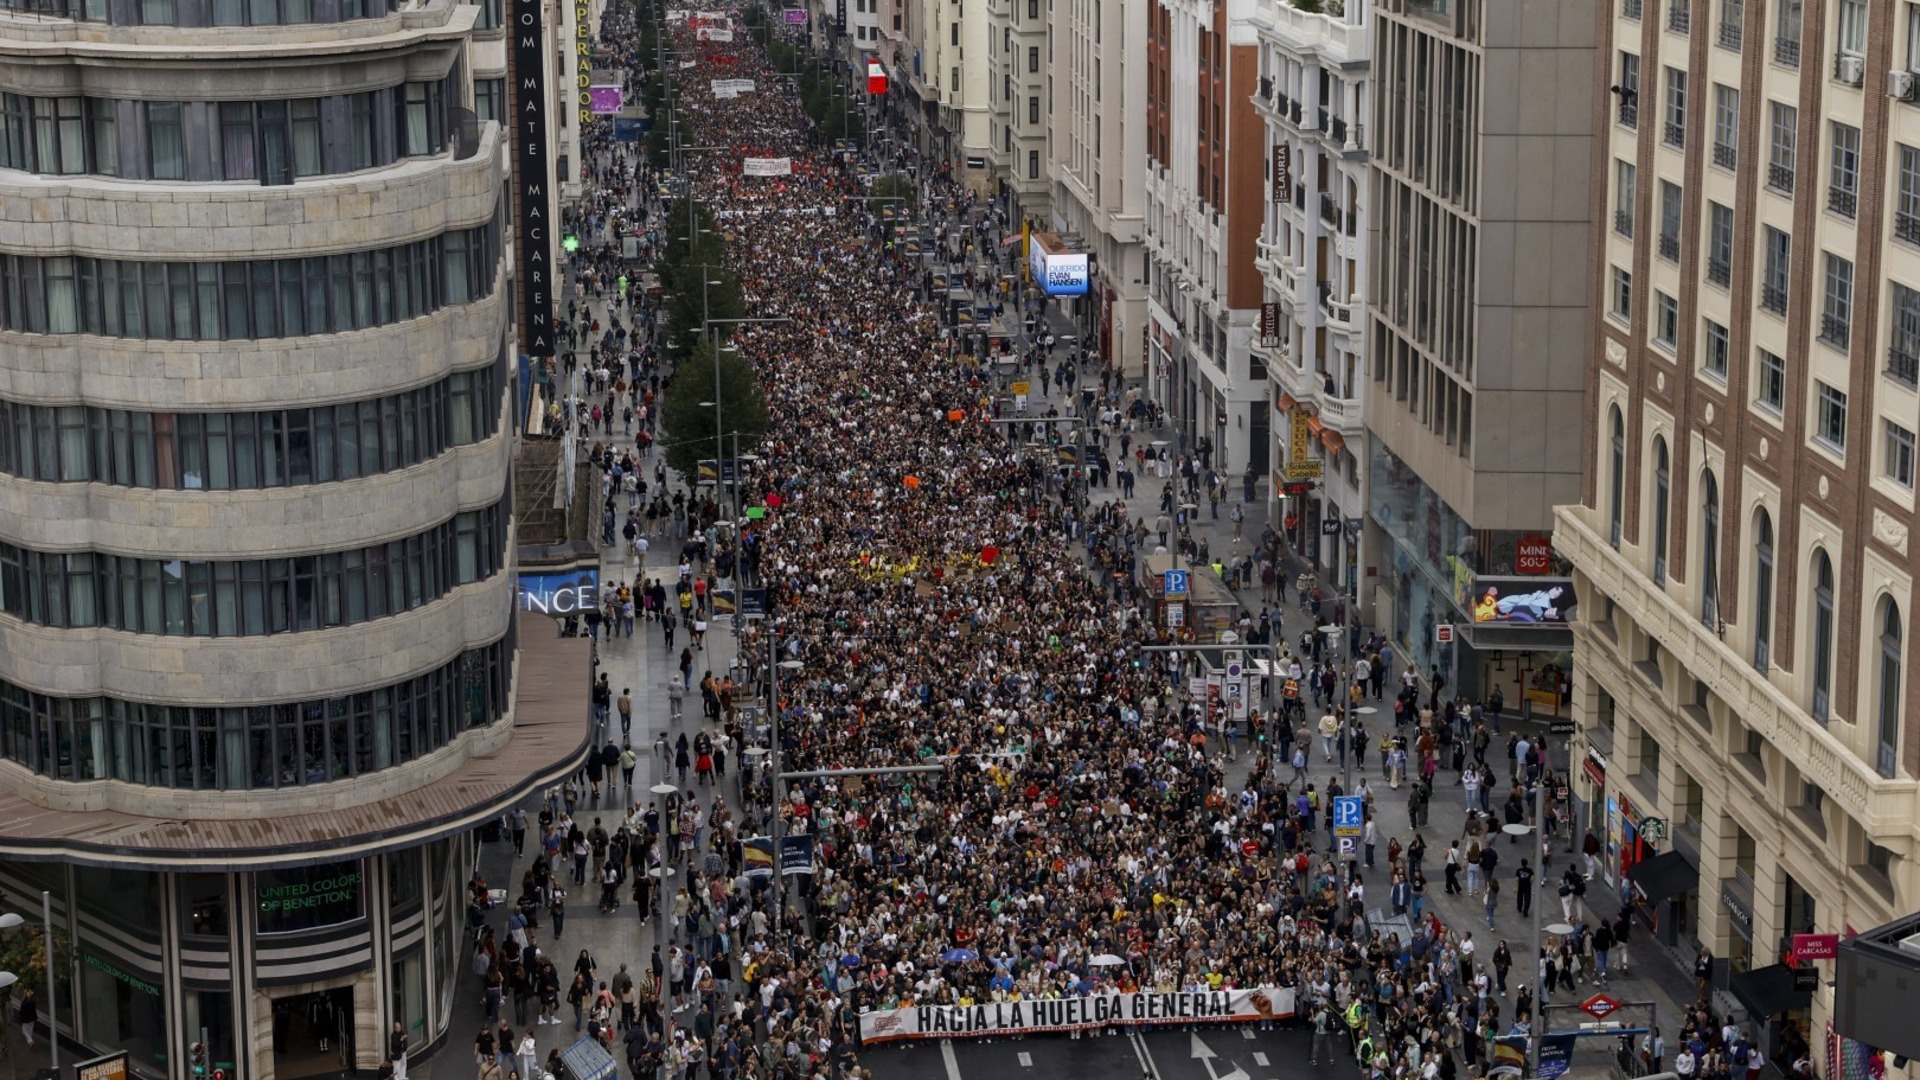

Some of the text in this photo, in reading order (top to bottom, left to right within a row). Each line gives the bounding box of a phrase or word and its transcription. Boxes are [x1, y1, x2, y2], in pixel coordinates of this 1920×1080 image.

[521, 0, 545, 347] OM MATE MACARENA
[1278, 147, 1286, 189] LAURIA
[1049, 264, 1086, 272] QUERIDO
[1049, 272, 1071, 280] EVAN
[1049, 278, 1082, 287] HANSEN
[1288, 462, 1319, 470] Soledad
[1289, 470, 1318, 478] Cabello
[1520, 546, 1549, 555] MINI
[1169, 573, 1183, 591] P
[518, 585, 594, 614] NCE
[1340, 801, 1357, 824] P
[1340, 838, 1353, 854] P
[260, 872, 362, 898] UNITED COLORS
[261, 900, 280, 911] OF
[918, 1004, 988, 1032] HACIA
[995, 1002, 1024, 1029] LA
[1032, 995, 1123, 1026] HUELGA
[1132, 991, 1236, 1019] GENERAL
